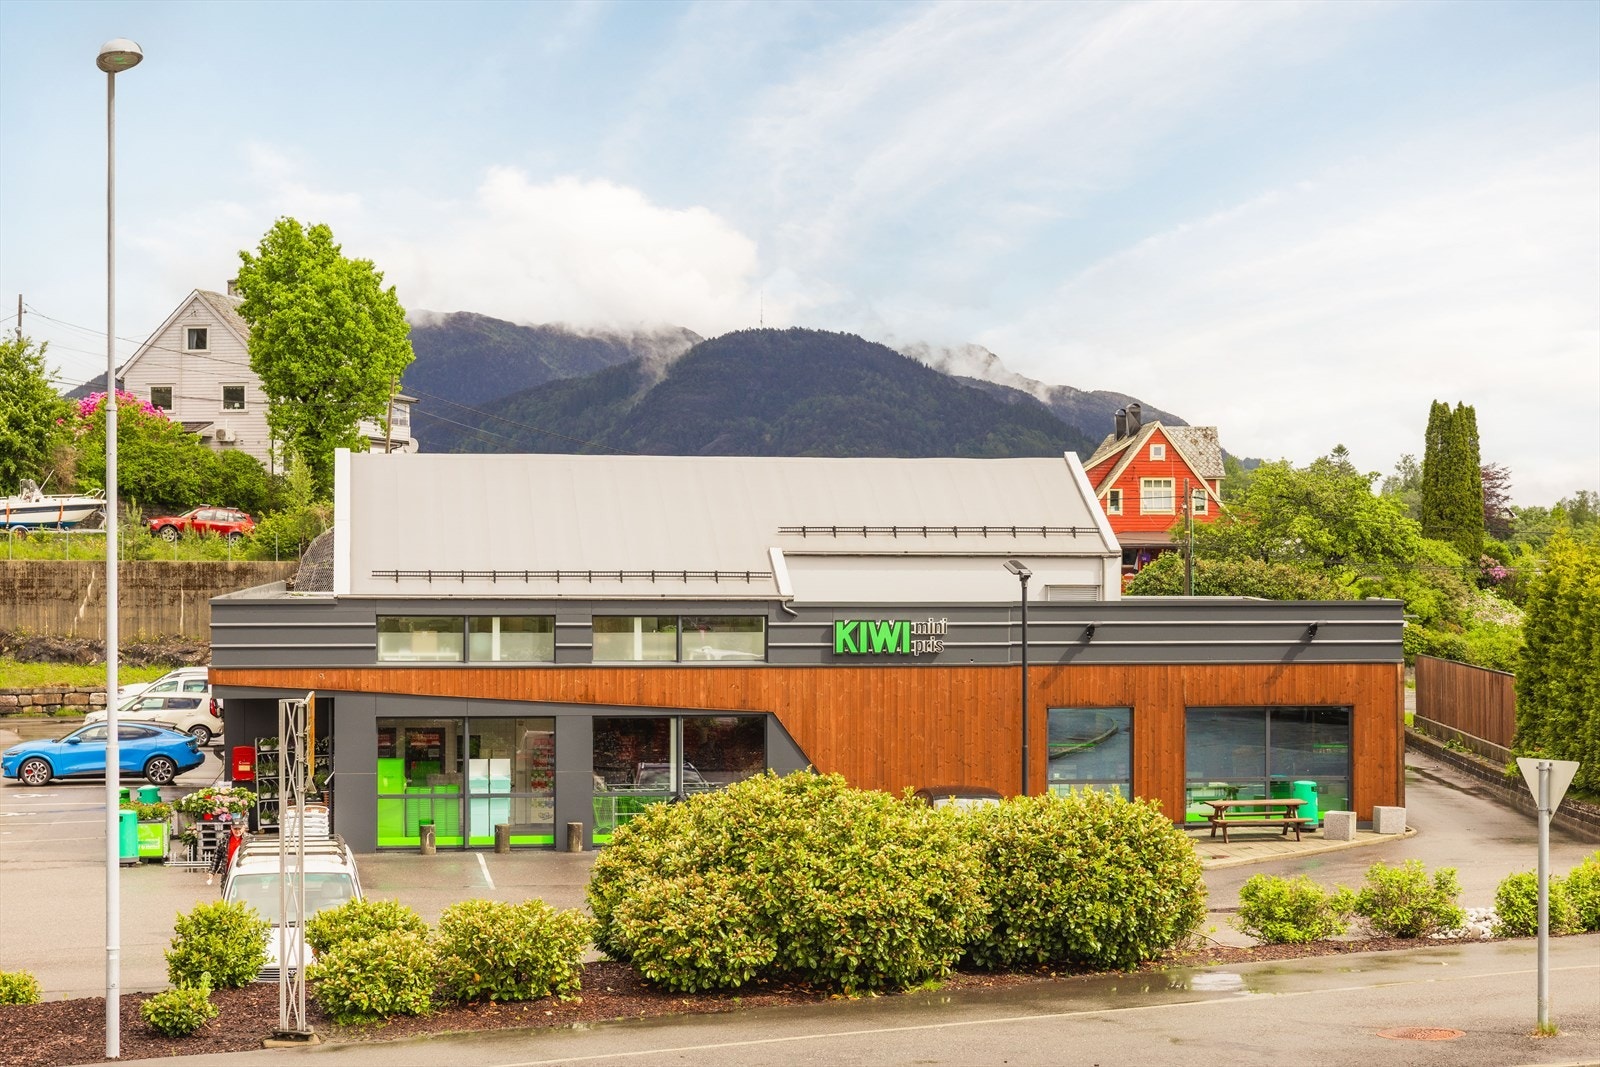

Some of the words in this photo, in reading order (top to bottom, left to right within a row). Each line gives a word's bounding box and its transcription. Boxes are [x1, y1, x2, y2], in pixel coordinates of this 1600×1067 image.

[914, 617, 947, 635] mini
[835, 620, 911, 654] KIWI
[914, 636, 944, 656] pris
